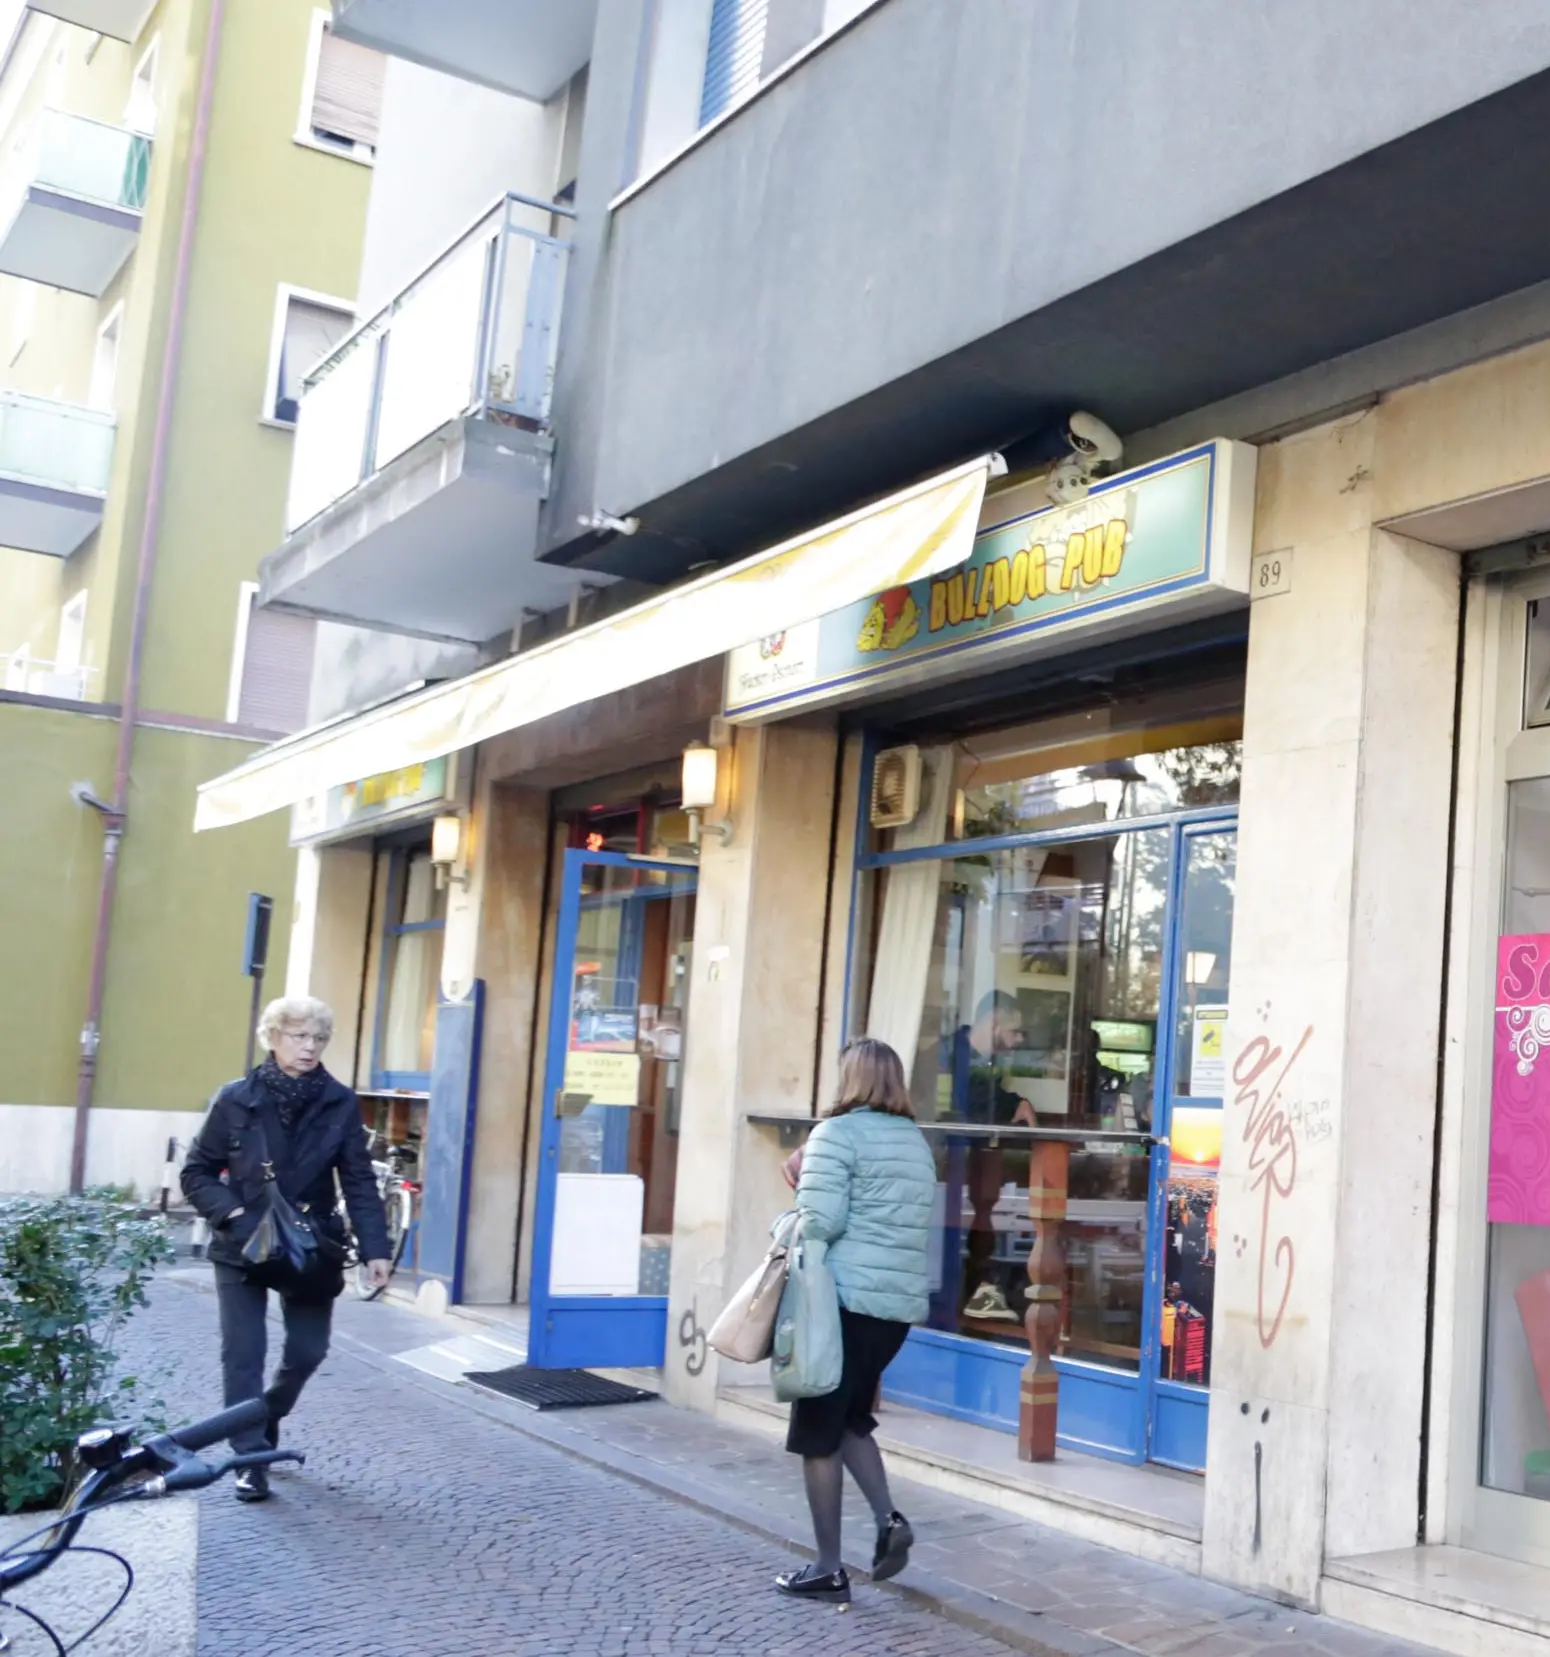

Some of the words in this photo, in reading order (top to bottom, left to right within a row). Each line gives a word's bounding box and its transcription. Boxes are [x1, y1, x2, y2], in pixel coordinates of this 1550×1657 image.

[928, 543, 1048, 633] BULLDOG
[1060, 519, 1128, 590] PUB
[1260, 560, 1281, 587] 89
